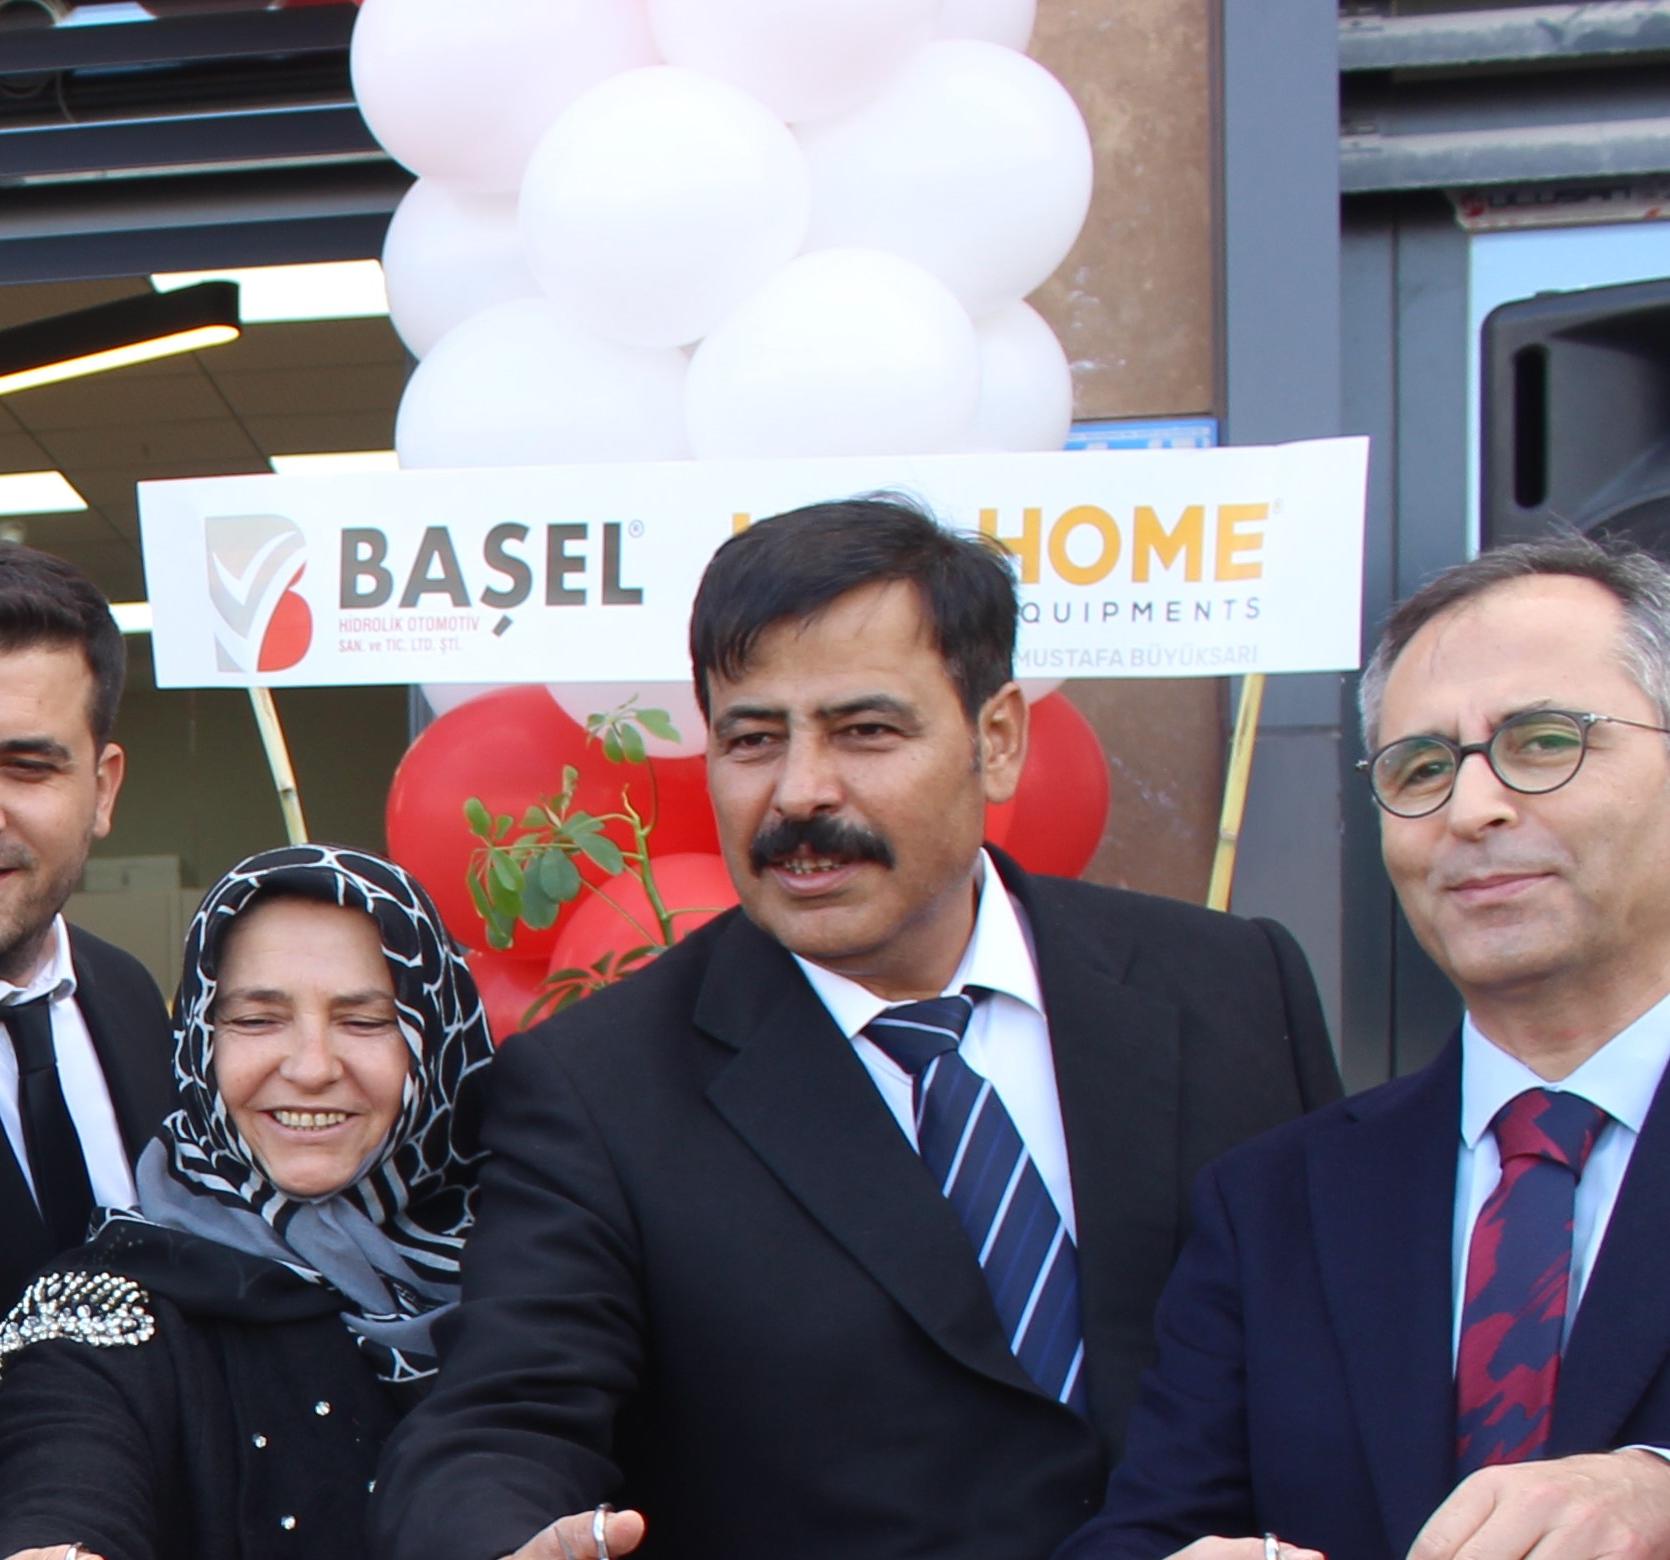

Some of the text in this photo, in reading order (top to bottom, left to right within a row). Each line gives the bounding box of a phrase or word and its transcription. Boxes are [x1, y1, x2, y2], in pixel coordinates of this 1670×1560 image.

[979, 502, 1270, 586] HOME
[338, 521, 644, 637] BAŞEL
[339, 611, 480, 633] HİDROLİK OTOMOTİV
[1019, 596, 1261, 623] QUIPMENTS
[369, 642, 381, 652] ve
[1013, 643, 1258, 668] MUSTAFA BÜYÜKSARI
